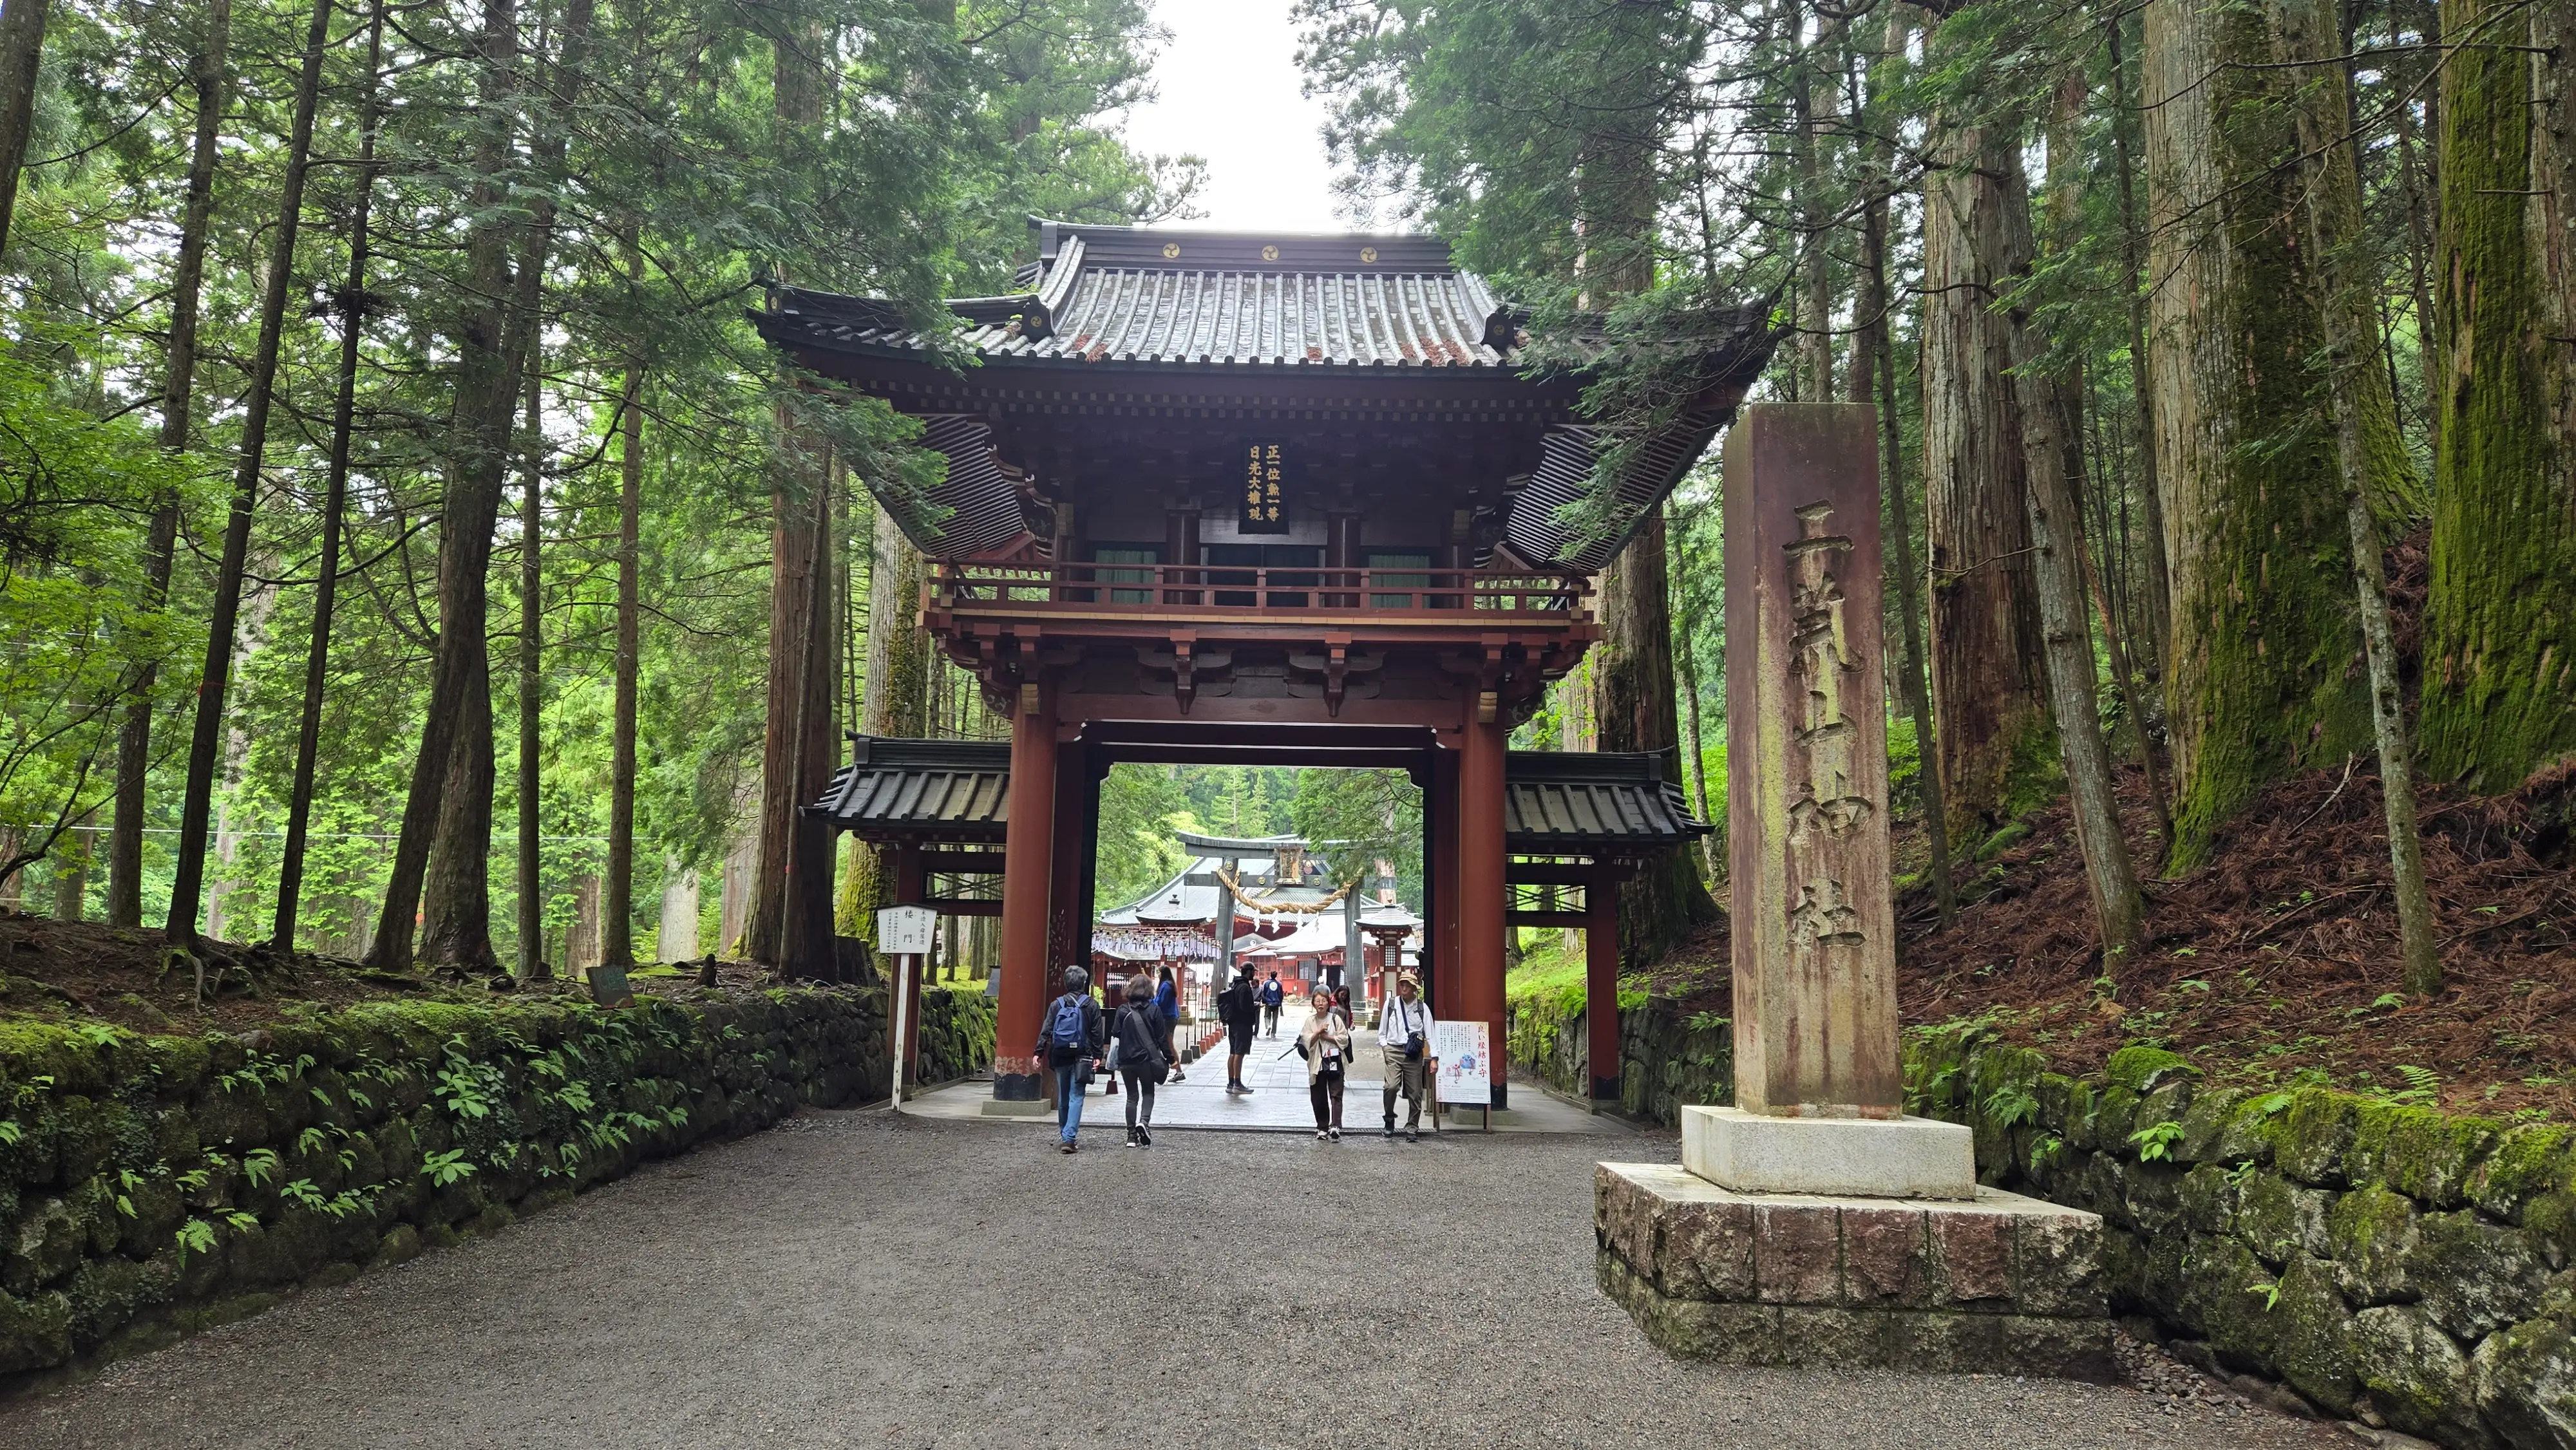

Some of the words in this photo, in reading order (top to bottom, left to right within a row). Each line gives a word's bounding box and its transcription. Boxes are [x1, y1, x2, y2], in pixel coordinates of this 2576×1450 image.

[1781, 498, 1875, 949] 二荒山神社
